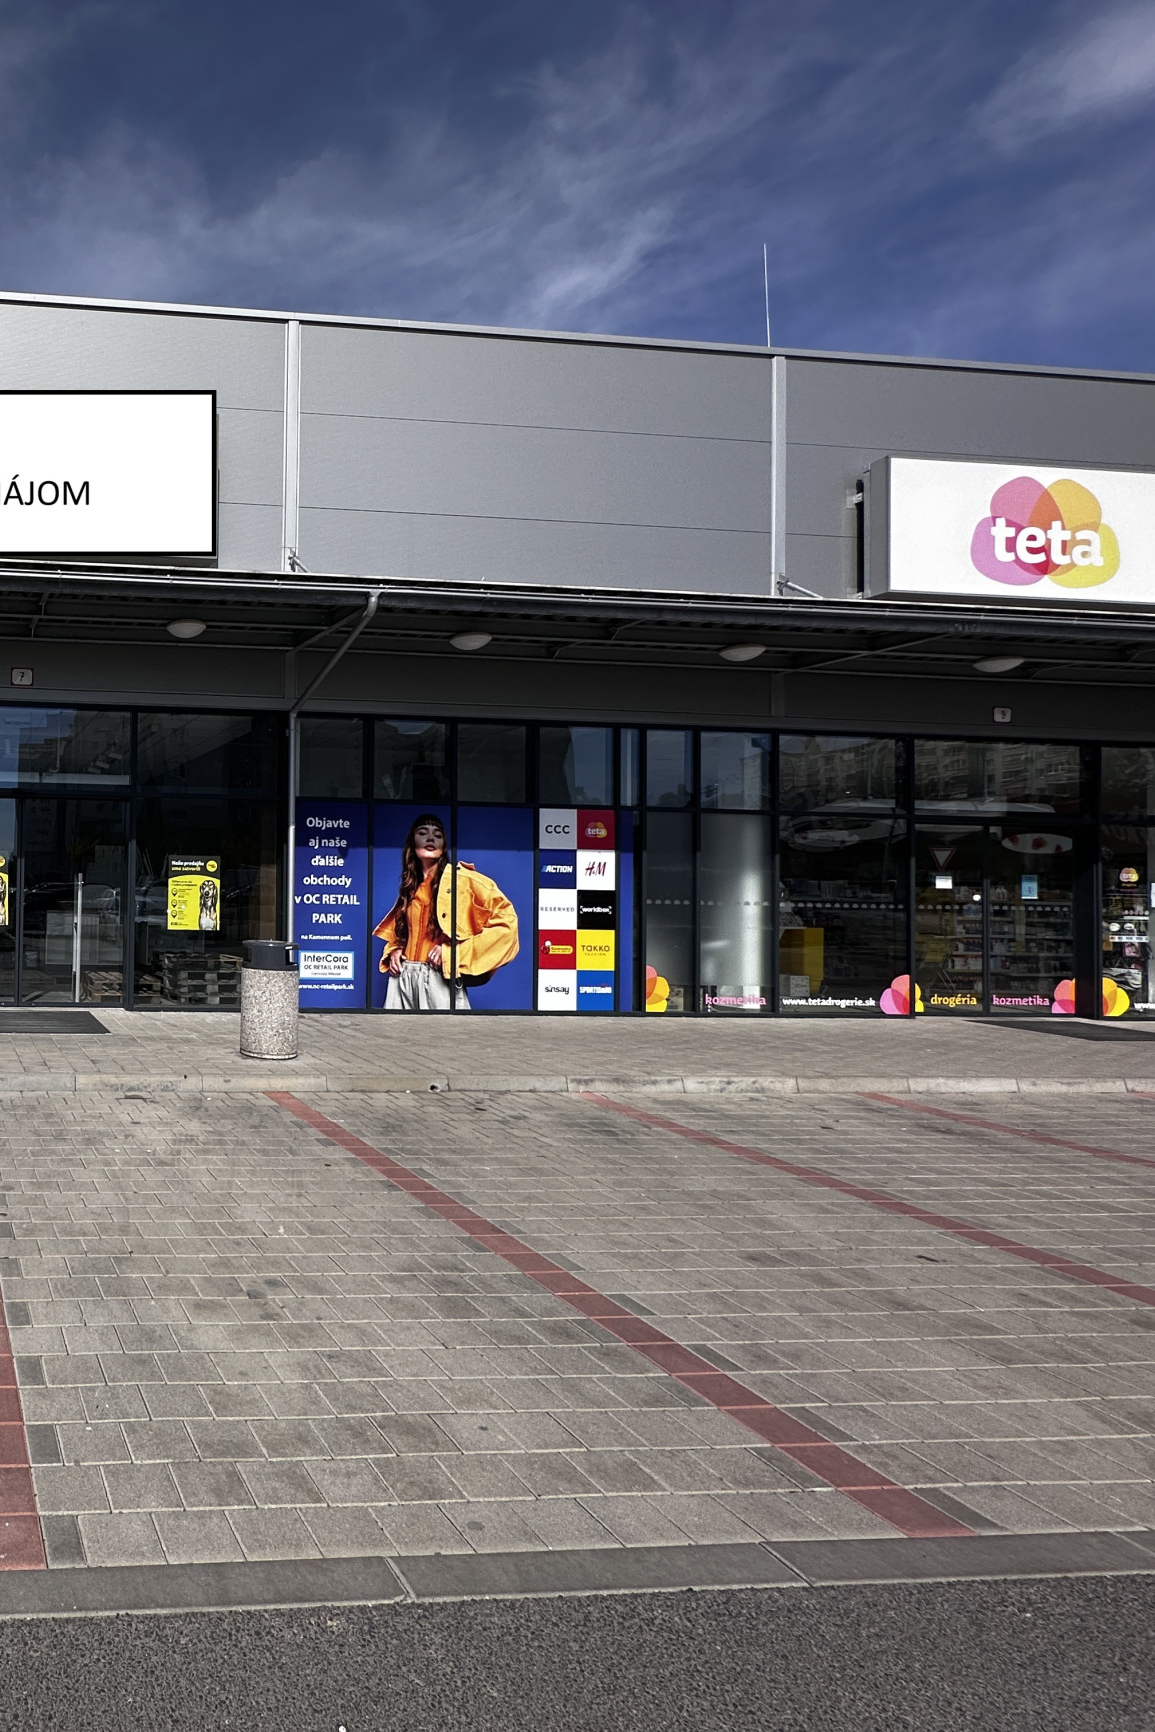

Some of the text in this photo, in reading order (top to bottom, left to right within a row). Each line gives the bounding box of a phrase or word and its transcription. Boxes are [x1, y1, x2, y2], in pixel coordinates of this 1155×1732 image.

[990, 517, 1104, 567] teta
[19, 671, 25, 682] 7
[306, 817, 350, 830] Objavte
[545, 824, 570, 835] CCC
[587, 827, 606, 835] teta
[309, 837, 348, 849] aj naše
[311, 855, 345, 867] ďalšie
[545, 865, 573, 873] ACTION
[585, 861, 607, 877] H&M
[302, 874, 352, 888] obchody
[294, 894, 360, 905] v OC RETAIL
[312, 913, 343, 924] PARK
[303, 954, 349, 963] InterCora
[544, 985, 570, 995] sinsay
[705, 994, 767, 1006] kozmetika
[782, 997, 876, 1009] www.tetadrogerie.sk
[930, 994, 977, 1007] drogéria
[992, 994, 1050, 1006] kozmetika
